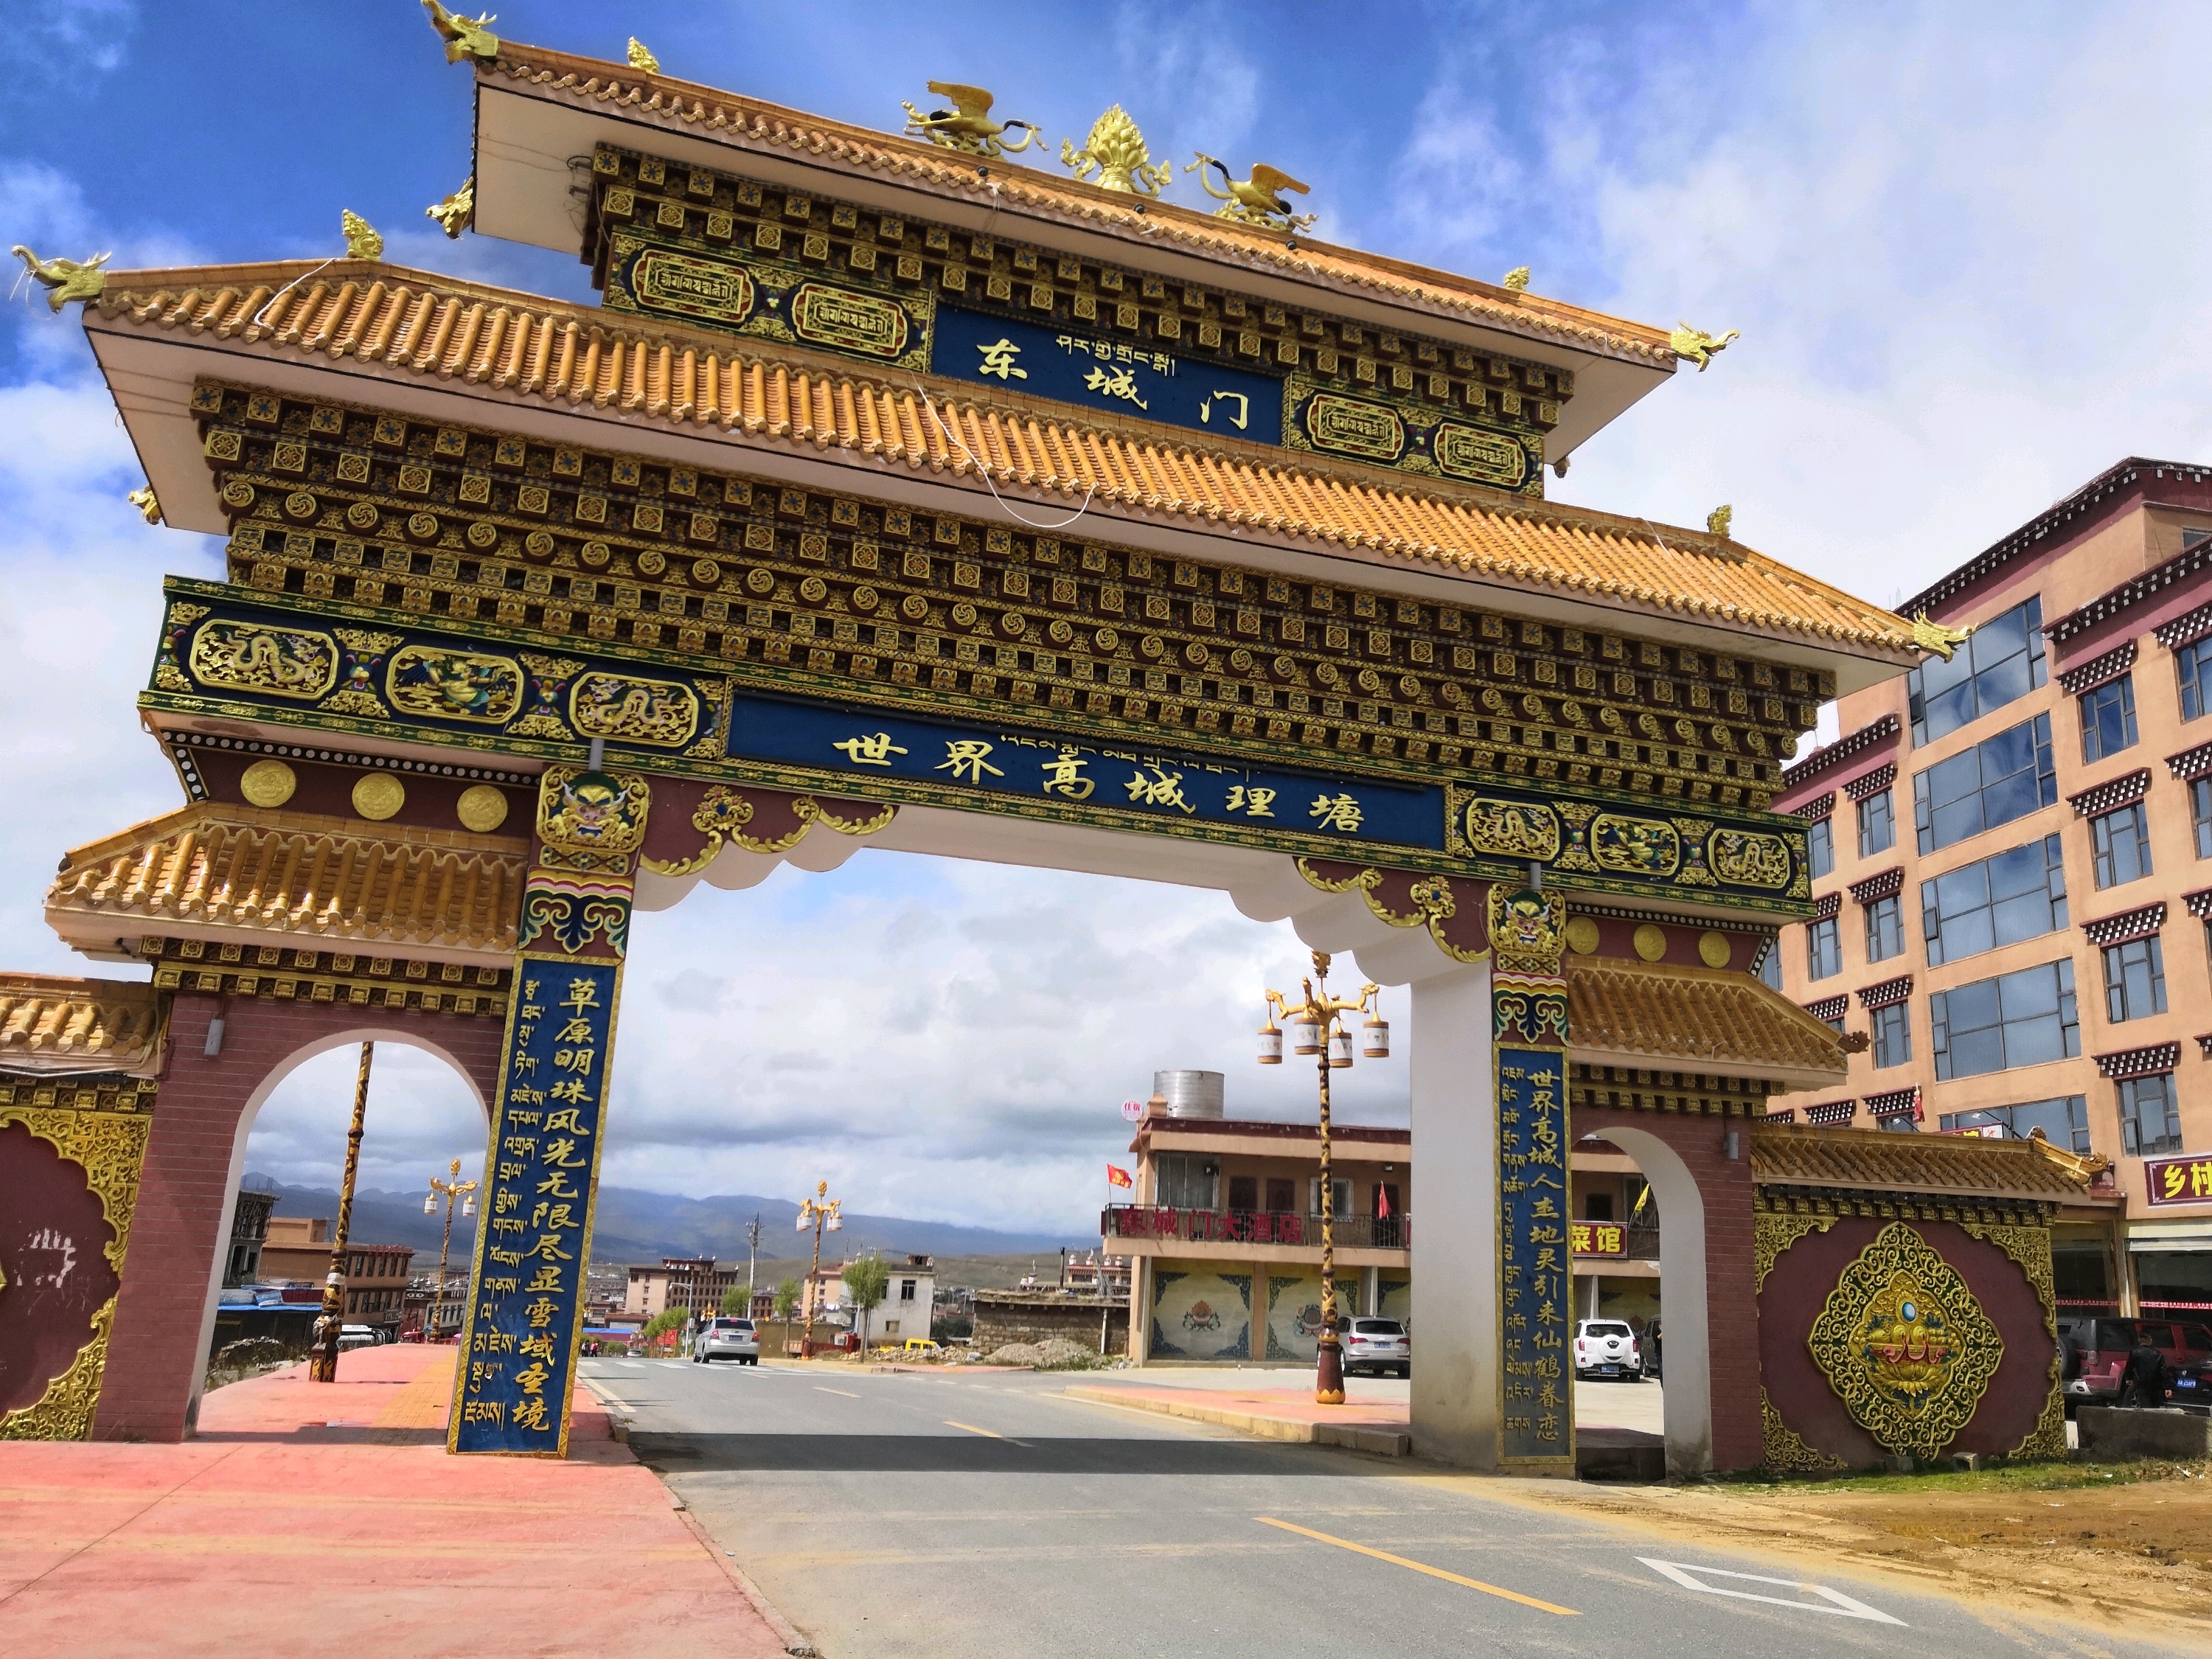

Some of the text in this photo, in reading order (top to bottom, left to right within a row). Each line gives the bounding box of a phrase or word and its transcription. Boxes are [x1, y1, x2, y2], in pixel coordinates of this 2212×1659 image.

[976, 338, 1248, 430] 东城门
[832, 733, 1365, 833] 世界高城理塘
[2165, 1162, 2212, 1198] 乡村
[1121, 1204, 1302, 1242] 东城门大酒店
[1572, 1225, 1621, 1252] 菜馆
